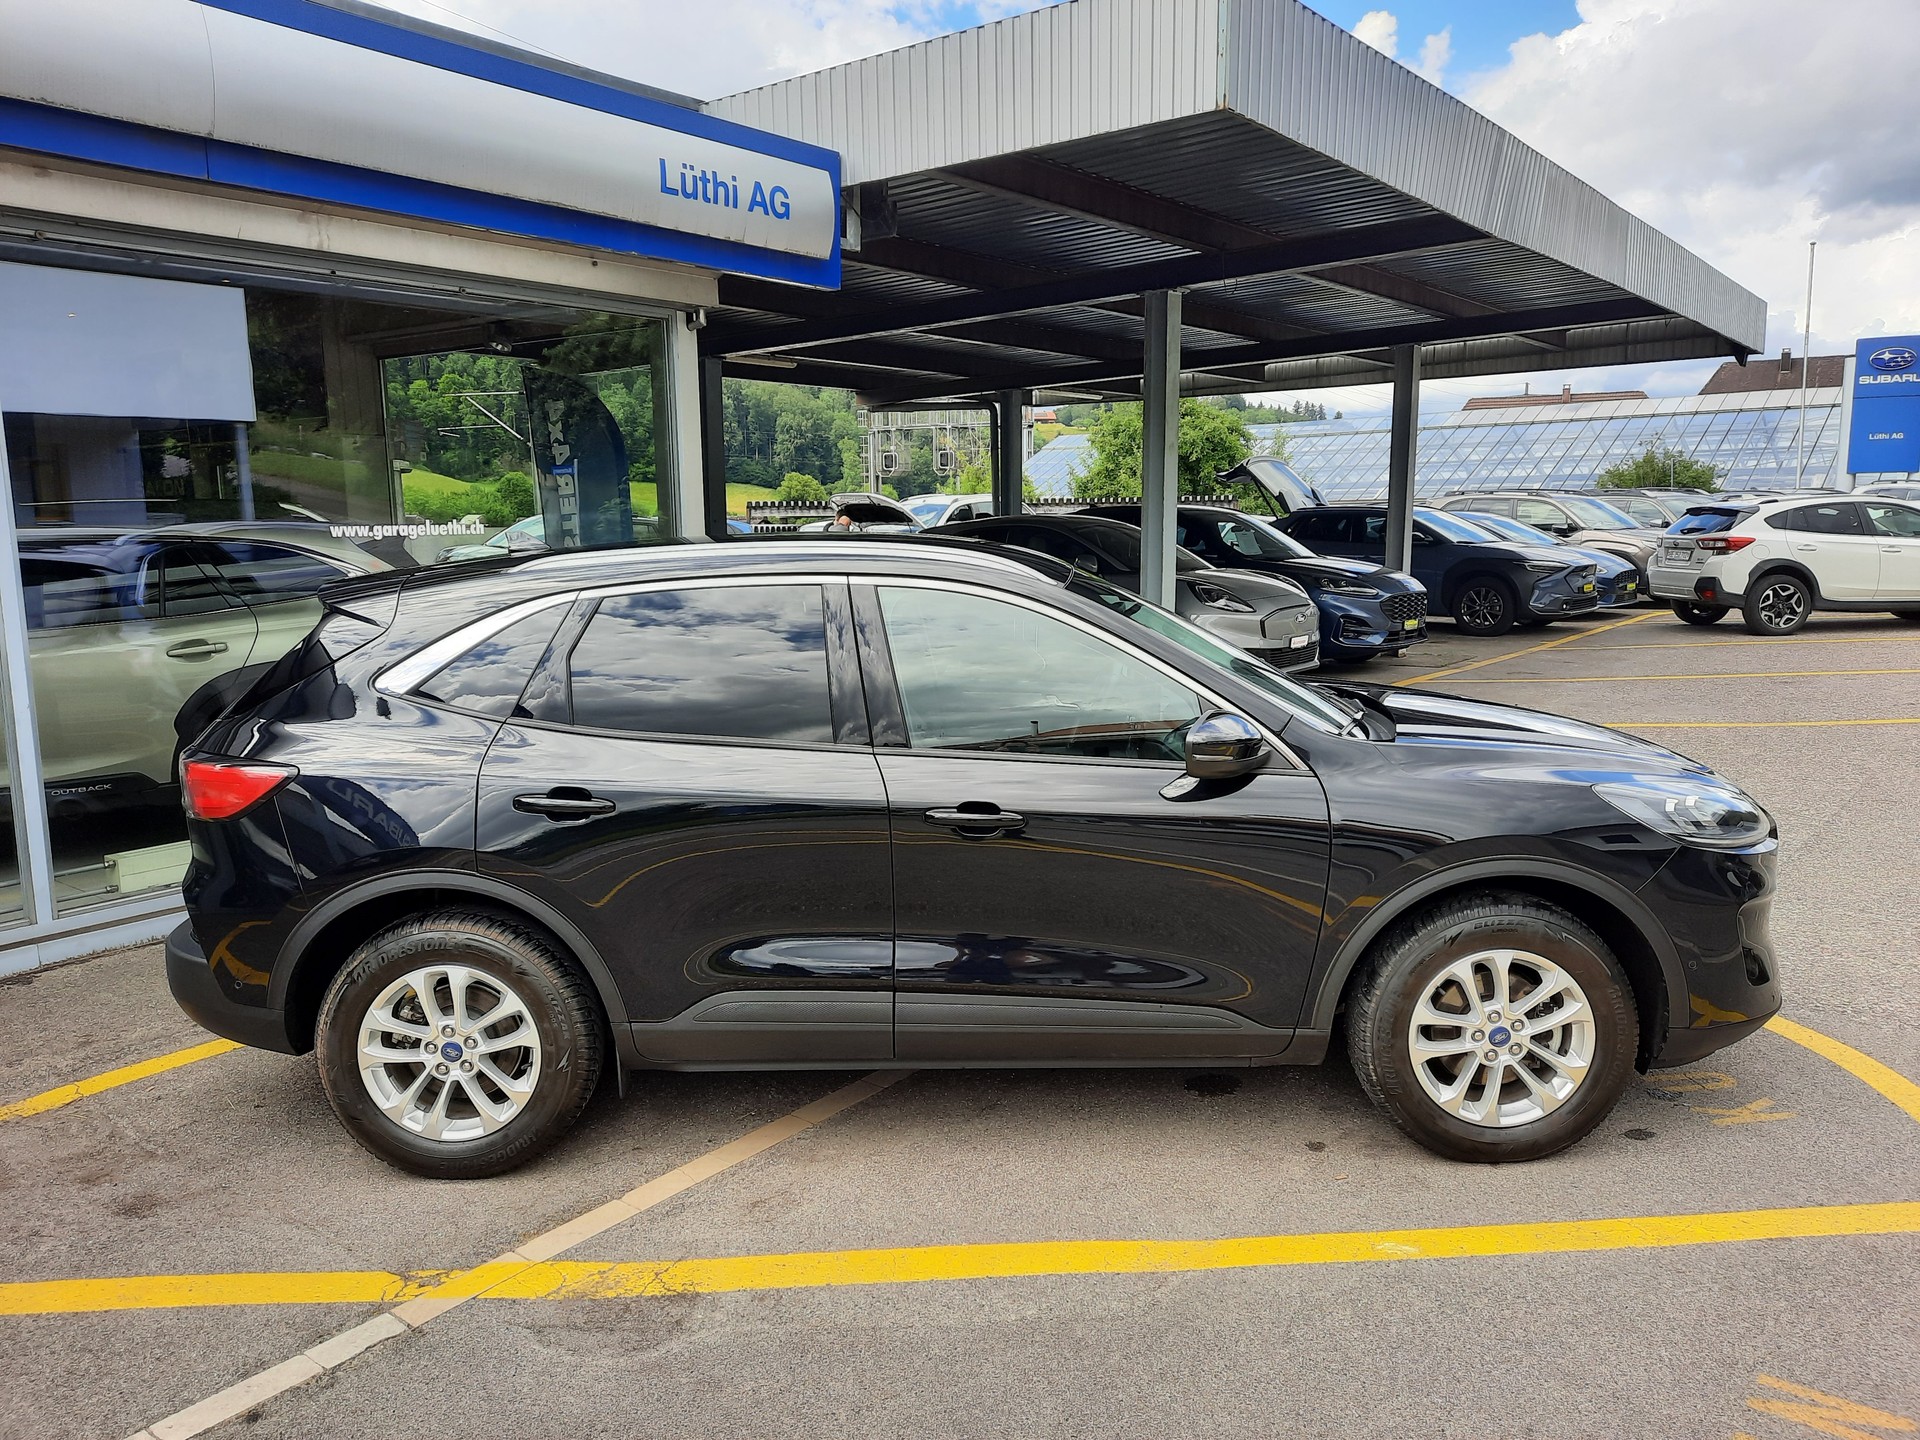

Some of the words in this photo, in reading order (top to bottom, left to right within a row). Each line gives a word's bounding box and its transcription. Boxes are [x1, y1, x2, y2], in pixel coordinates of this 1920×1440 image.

[659, 158, 738, 209] Lüthi
[747, 180, 790, 220] AG
[1890, 432, 1904, 440] AG
[329, 519, 485, 540] www.garageluethi.ch
[51, 783, 112, 796] OUTBACK
